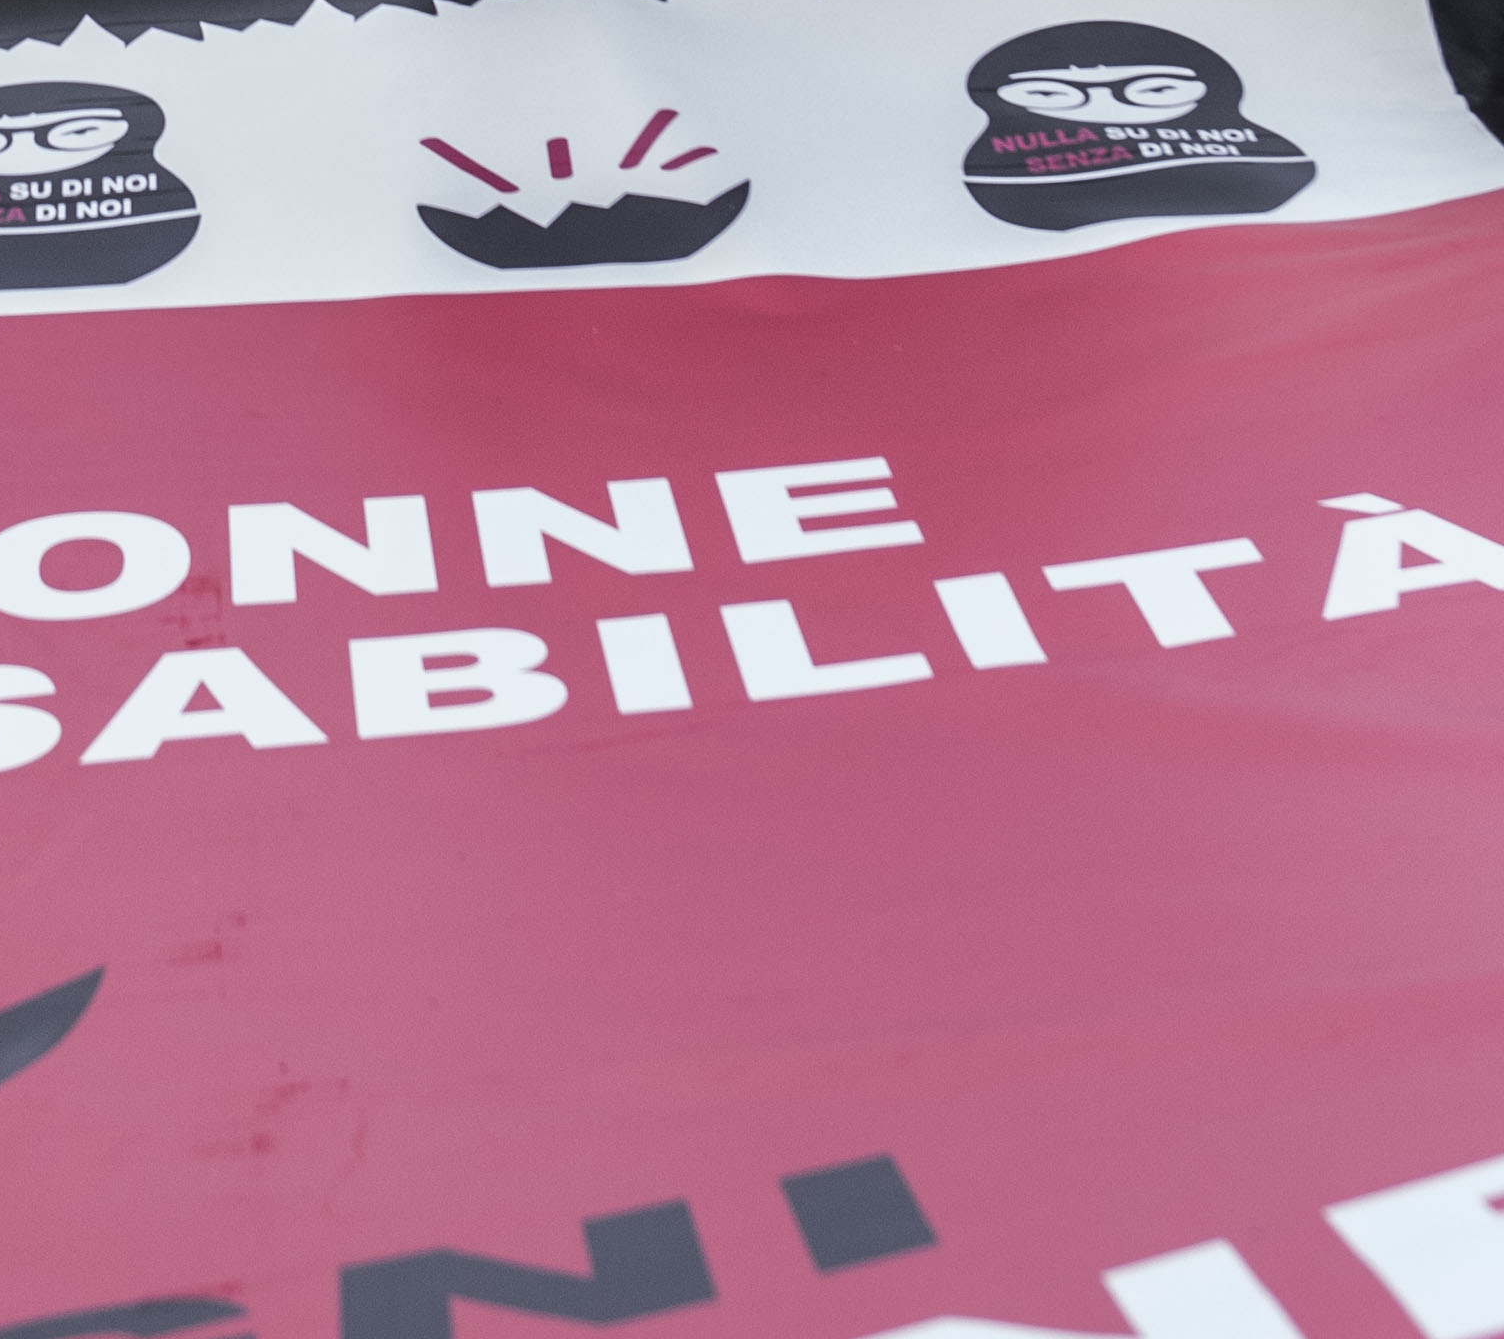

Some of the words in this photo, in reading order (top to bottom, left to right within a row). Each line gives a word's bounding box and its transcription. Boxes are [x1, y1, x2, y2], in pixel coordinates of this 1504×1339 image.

[992, 127, 1098, 154] NULLA
[1104, 126, 1150, 141] SU
[1156, 127, 1191, 142] DI
[1197, 128, 1259, 143] NOI
[1025, 144, 1134, 174] SENZA
[1139, 141, 1174, 158] DI
[1179, 142, 1241, 157] NOI
[9, 180, 52, 201] SU
[61, 178, 93, 197] DI
[102, 173, 158, 195] NOI
[35, 203, 67, 222] DI
[76, 198, 132, 219] NOI
